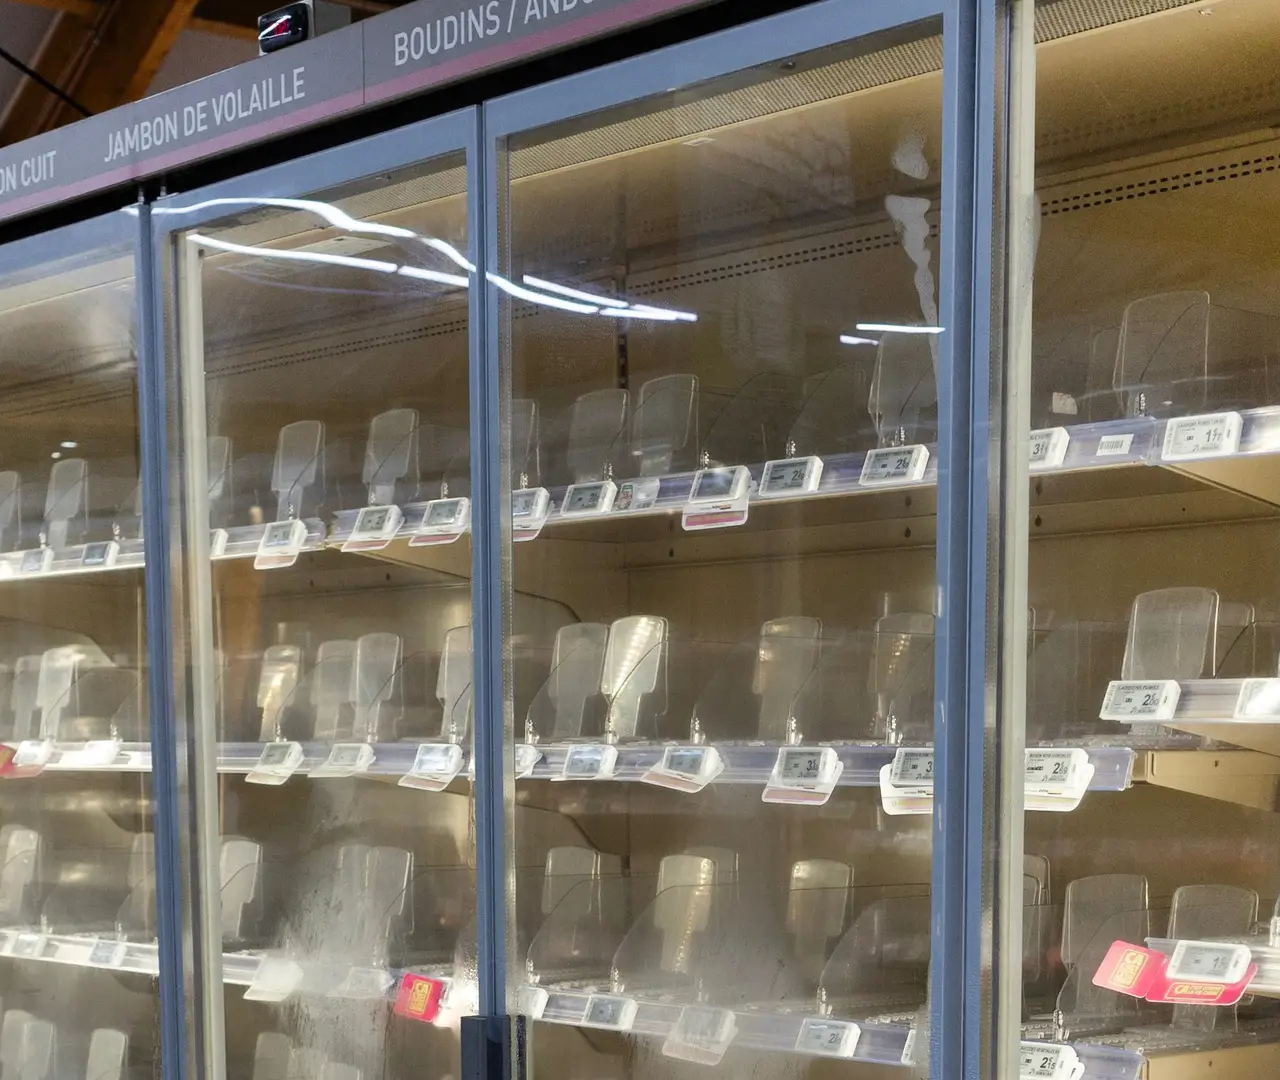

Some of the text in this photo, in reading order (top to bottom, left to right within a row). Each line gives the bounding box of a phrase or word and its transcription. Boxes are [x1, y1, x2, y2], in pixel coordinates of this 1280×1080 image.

[394, 2, 501, 66] BOUDINS
[103, 66, 305, 163] JAMBON DE VOLAILLE
[20, 150, 57, 188] CUIT
